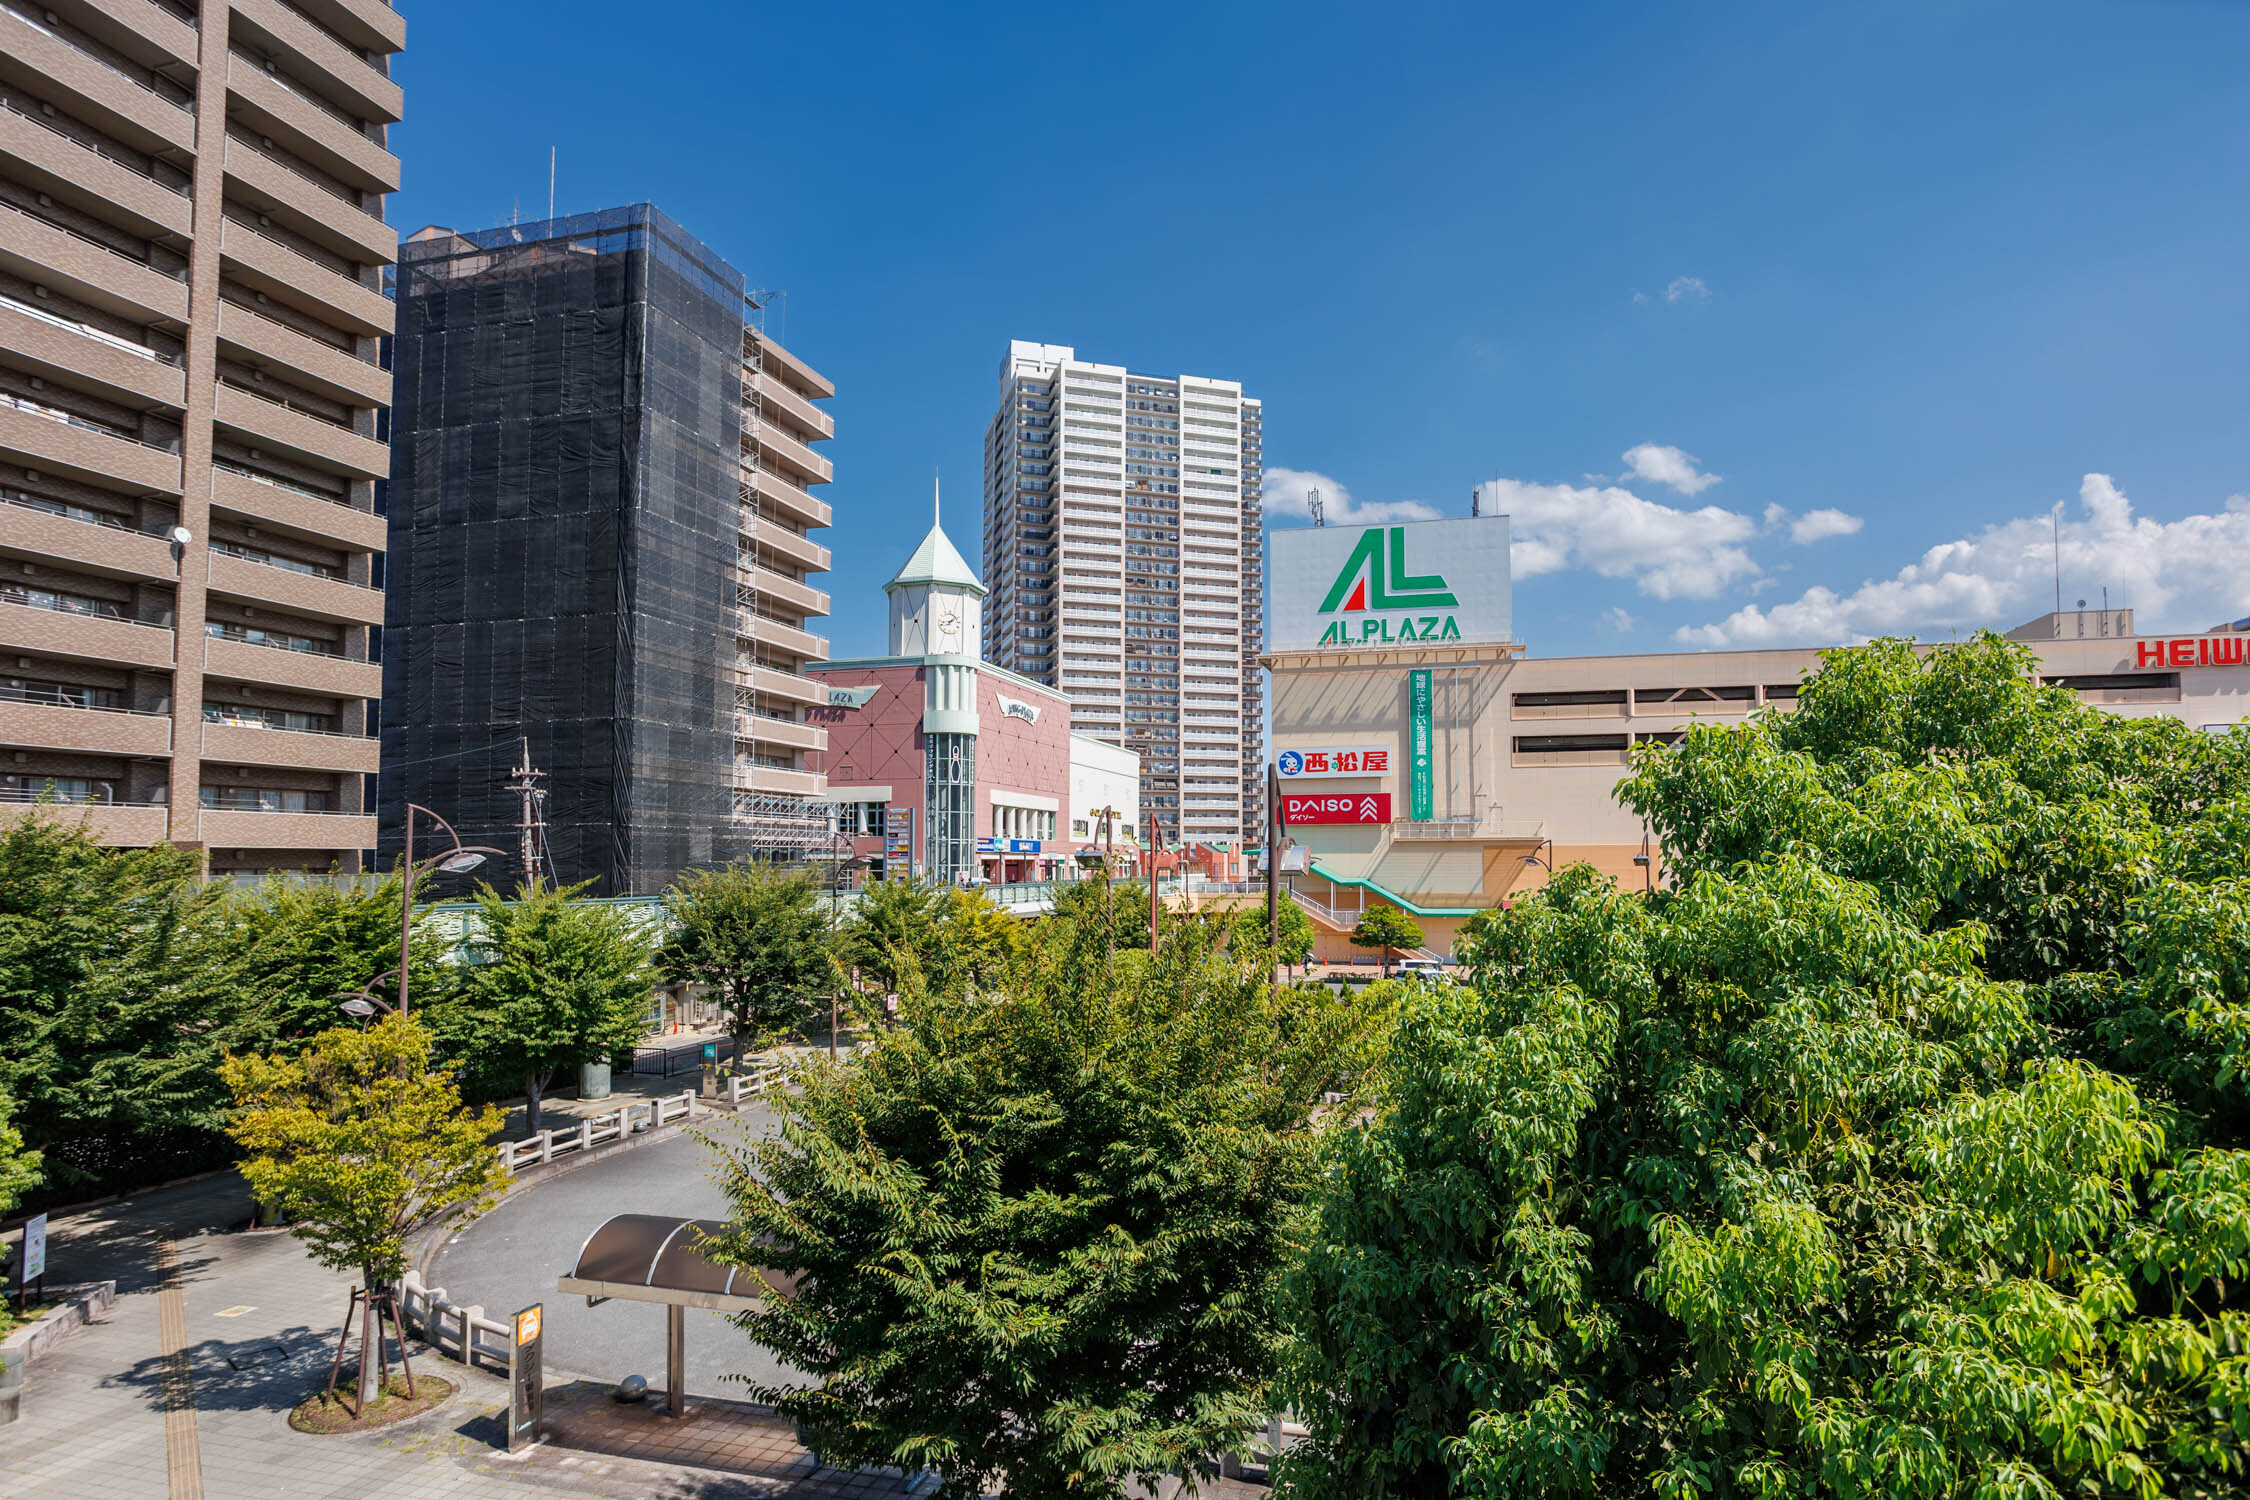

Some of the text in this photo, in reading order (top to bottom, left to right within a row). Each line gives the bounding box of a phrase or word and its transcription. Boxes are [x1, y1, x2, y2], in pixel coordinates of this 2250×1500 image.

[2137, 637, 2250, 668] HEIW
[1304, 751, 1388, 772] 西松屋
[1289, 799, 1353, 812] DAISO
